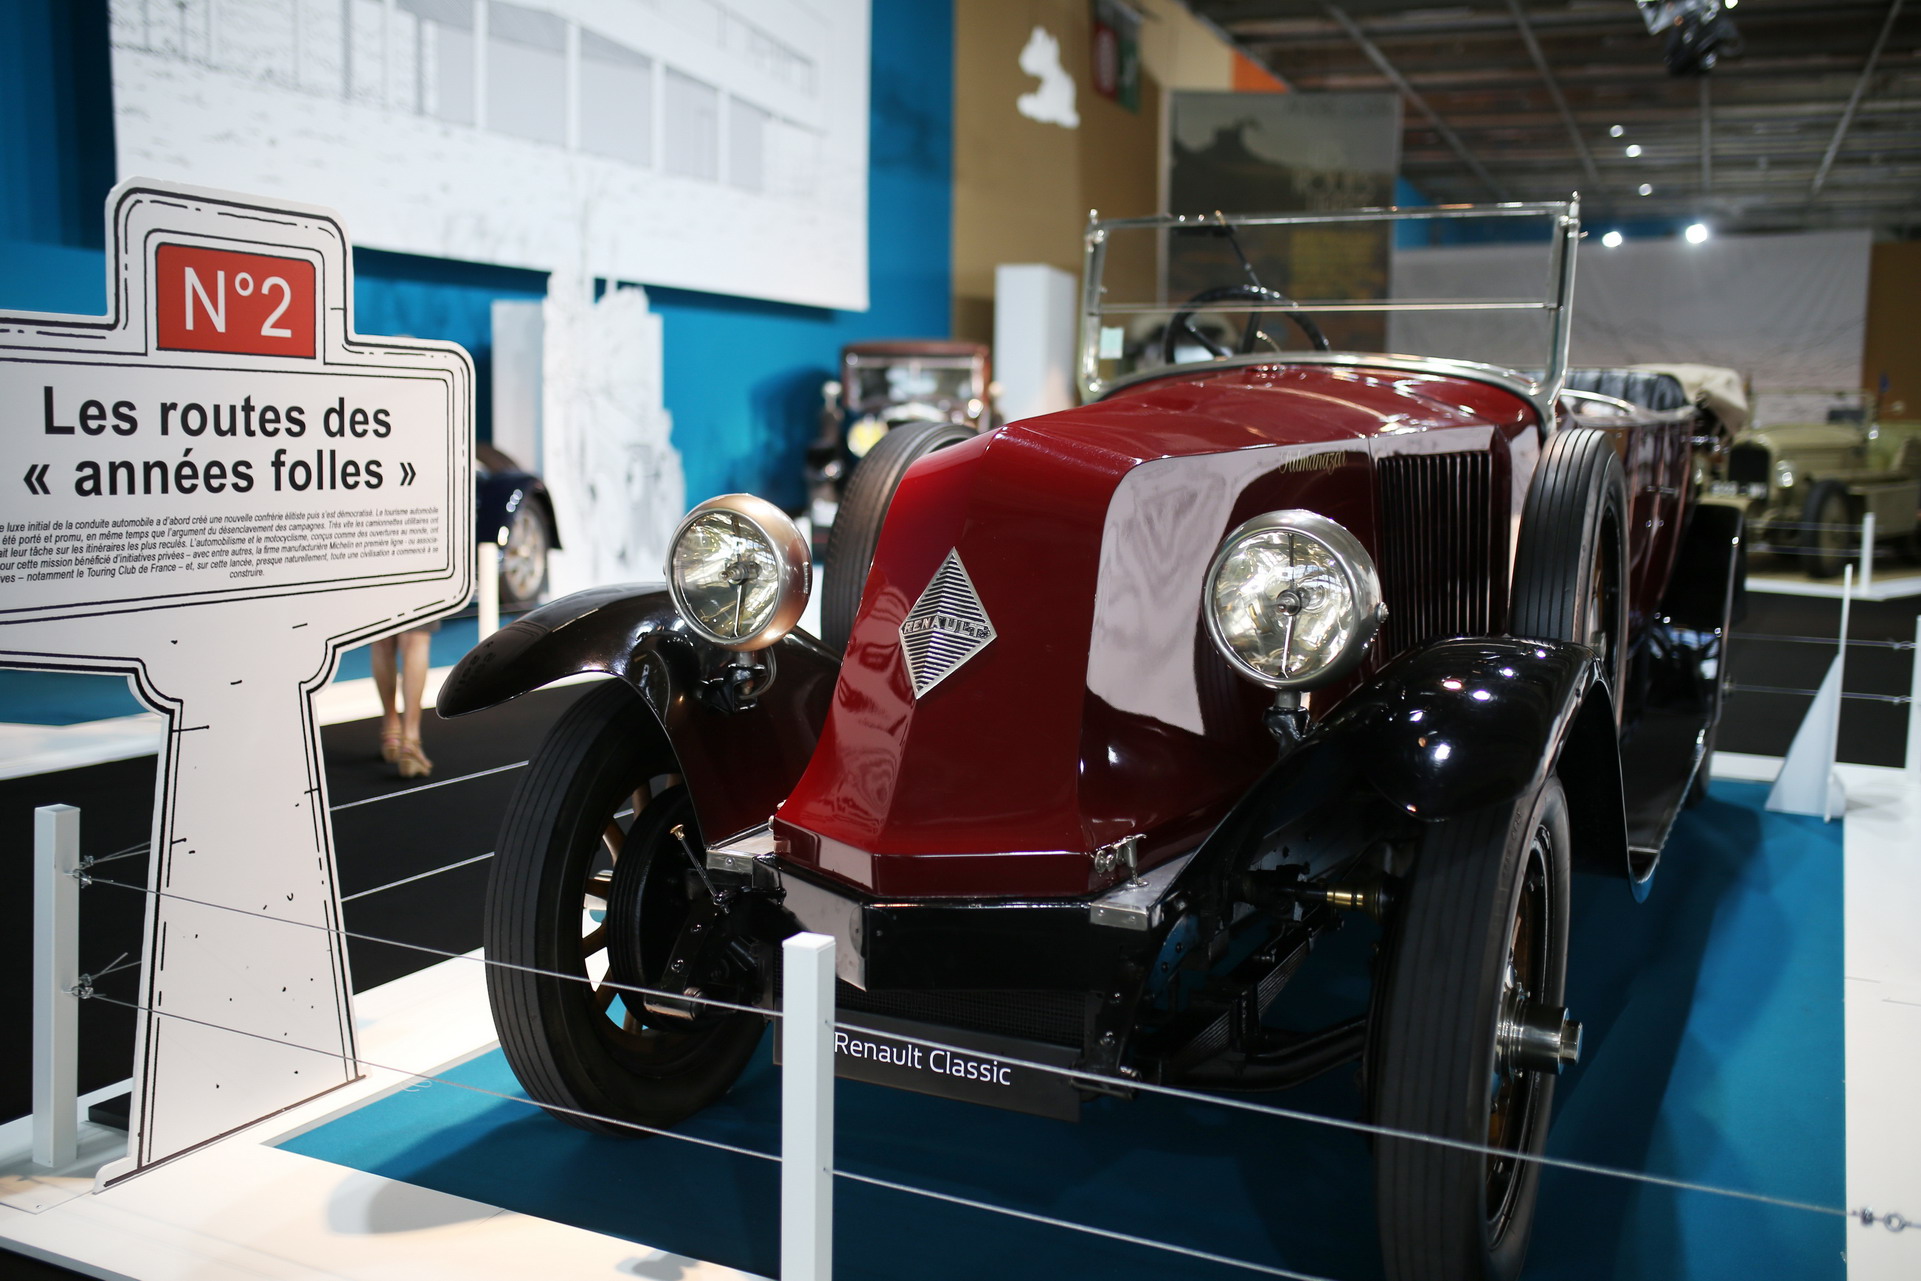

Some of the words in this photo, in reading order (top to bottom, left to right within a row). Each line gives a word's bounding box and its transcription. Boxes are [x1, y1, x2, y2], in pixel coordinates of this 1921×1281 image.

[184, 266, 292, 338] N°2
[44, 386, 138, 436] Les
[160, 394, 306, 437] routes
[323, 397, 392, 438] des
[23, 463, 51, 495] «
[74, 448, 254, 497] années
[271, 449, 383, 491] folles
[399, 462, 417, 486] »
[2, 535, 16, 546] été
[18, 534, 41, 546] porté
[44, 533, 53, 543] et
[54, 533, 83, 544] promu,
[86, 533, 96, 541] en
[99, 531, 123, 540] même
[126, 530, 149, 541] temps
[151, 530, 165, 540] que
[208, 526, 217, 535] du
[219, 524, 273, 535] désenclavement
[275, 523, 287, 532] des
[289, 522, 325, 532] campagnes.
[355, 519, 364, 527] les
[366, 518, 403, 527] camionnettes
[7, 522, 25, 532] luxe
[28, 521, 51, 531] initial
[53, 521, 63, 530] de
[65, 520, 73, 529] la
[75, 519, 109, 529] conduite
[112, 517, 154, 528] automobile
[192, 515, 207, 524] créé
[224, 513, 253, 523] nouvelle
[255, 512, 283, 522] confrérie
[285, 511, 305, 520] élitiste
[307, 511, 320, 520] puis
[10, 548, 28, 557] leur
[30, 546, 53, 556] tâche
[56, 546, 70, 555] sur
[71, 544, 83, 554] les
[86, 543, 125, 553] itinéraires
[127, 541, 138, 551] les
[141, 540, 157, 552] plus
[159, 539, 187, 550] reculés.
[248, 535, 254, 544] et
[256, 535, 262, 543] le
[311, 532, 333, 542] conçus
[334, 531, 355, 539] comme
[357, 529, 368, 537] des
[369, 528, 400, 537] ouvertures
[17, 559, 38, 569] cette
[40, 558, 73, 568] mission
[75, 554, 111, 566] bénéficié
[158, 551, 184, 562] privées
[193, 550, 210, 559] avec
[211, 548, 229, 557] entre
[231, 546, 254, 557] autres,
[256, 545, 262, 554] la
[263, 545, 280, 554] firme
[281, 542, 328, 552] manufacturière
[329, 539, 354, 549] Michelin
[27, 570, 74, 581] notamment
[76, 569, 84, 577] le
[87, 567, 116, 578] Touring
[118, 563, 136, 575] Club
[138, 563, 148, 573] de
[151, 563, 177, 572] France
[185, 561, 195, 570] et,
[197, 561, 209, 569] sur
[211, 559, 228, 568] cette
[230, 558, 254, 567] lancée,
[256, 556, 283, 567] presque
[331, 552, 346, 560] toute
[229, 569, 264, 578] construire.
[834, 1031, 922, 1069] Renault
[929, 1049, 1011, 1085] Classic
